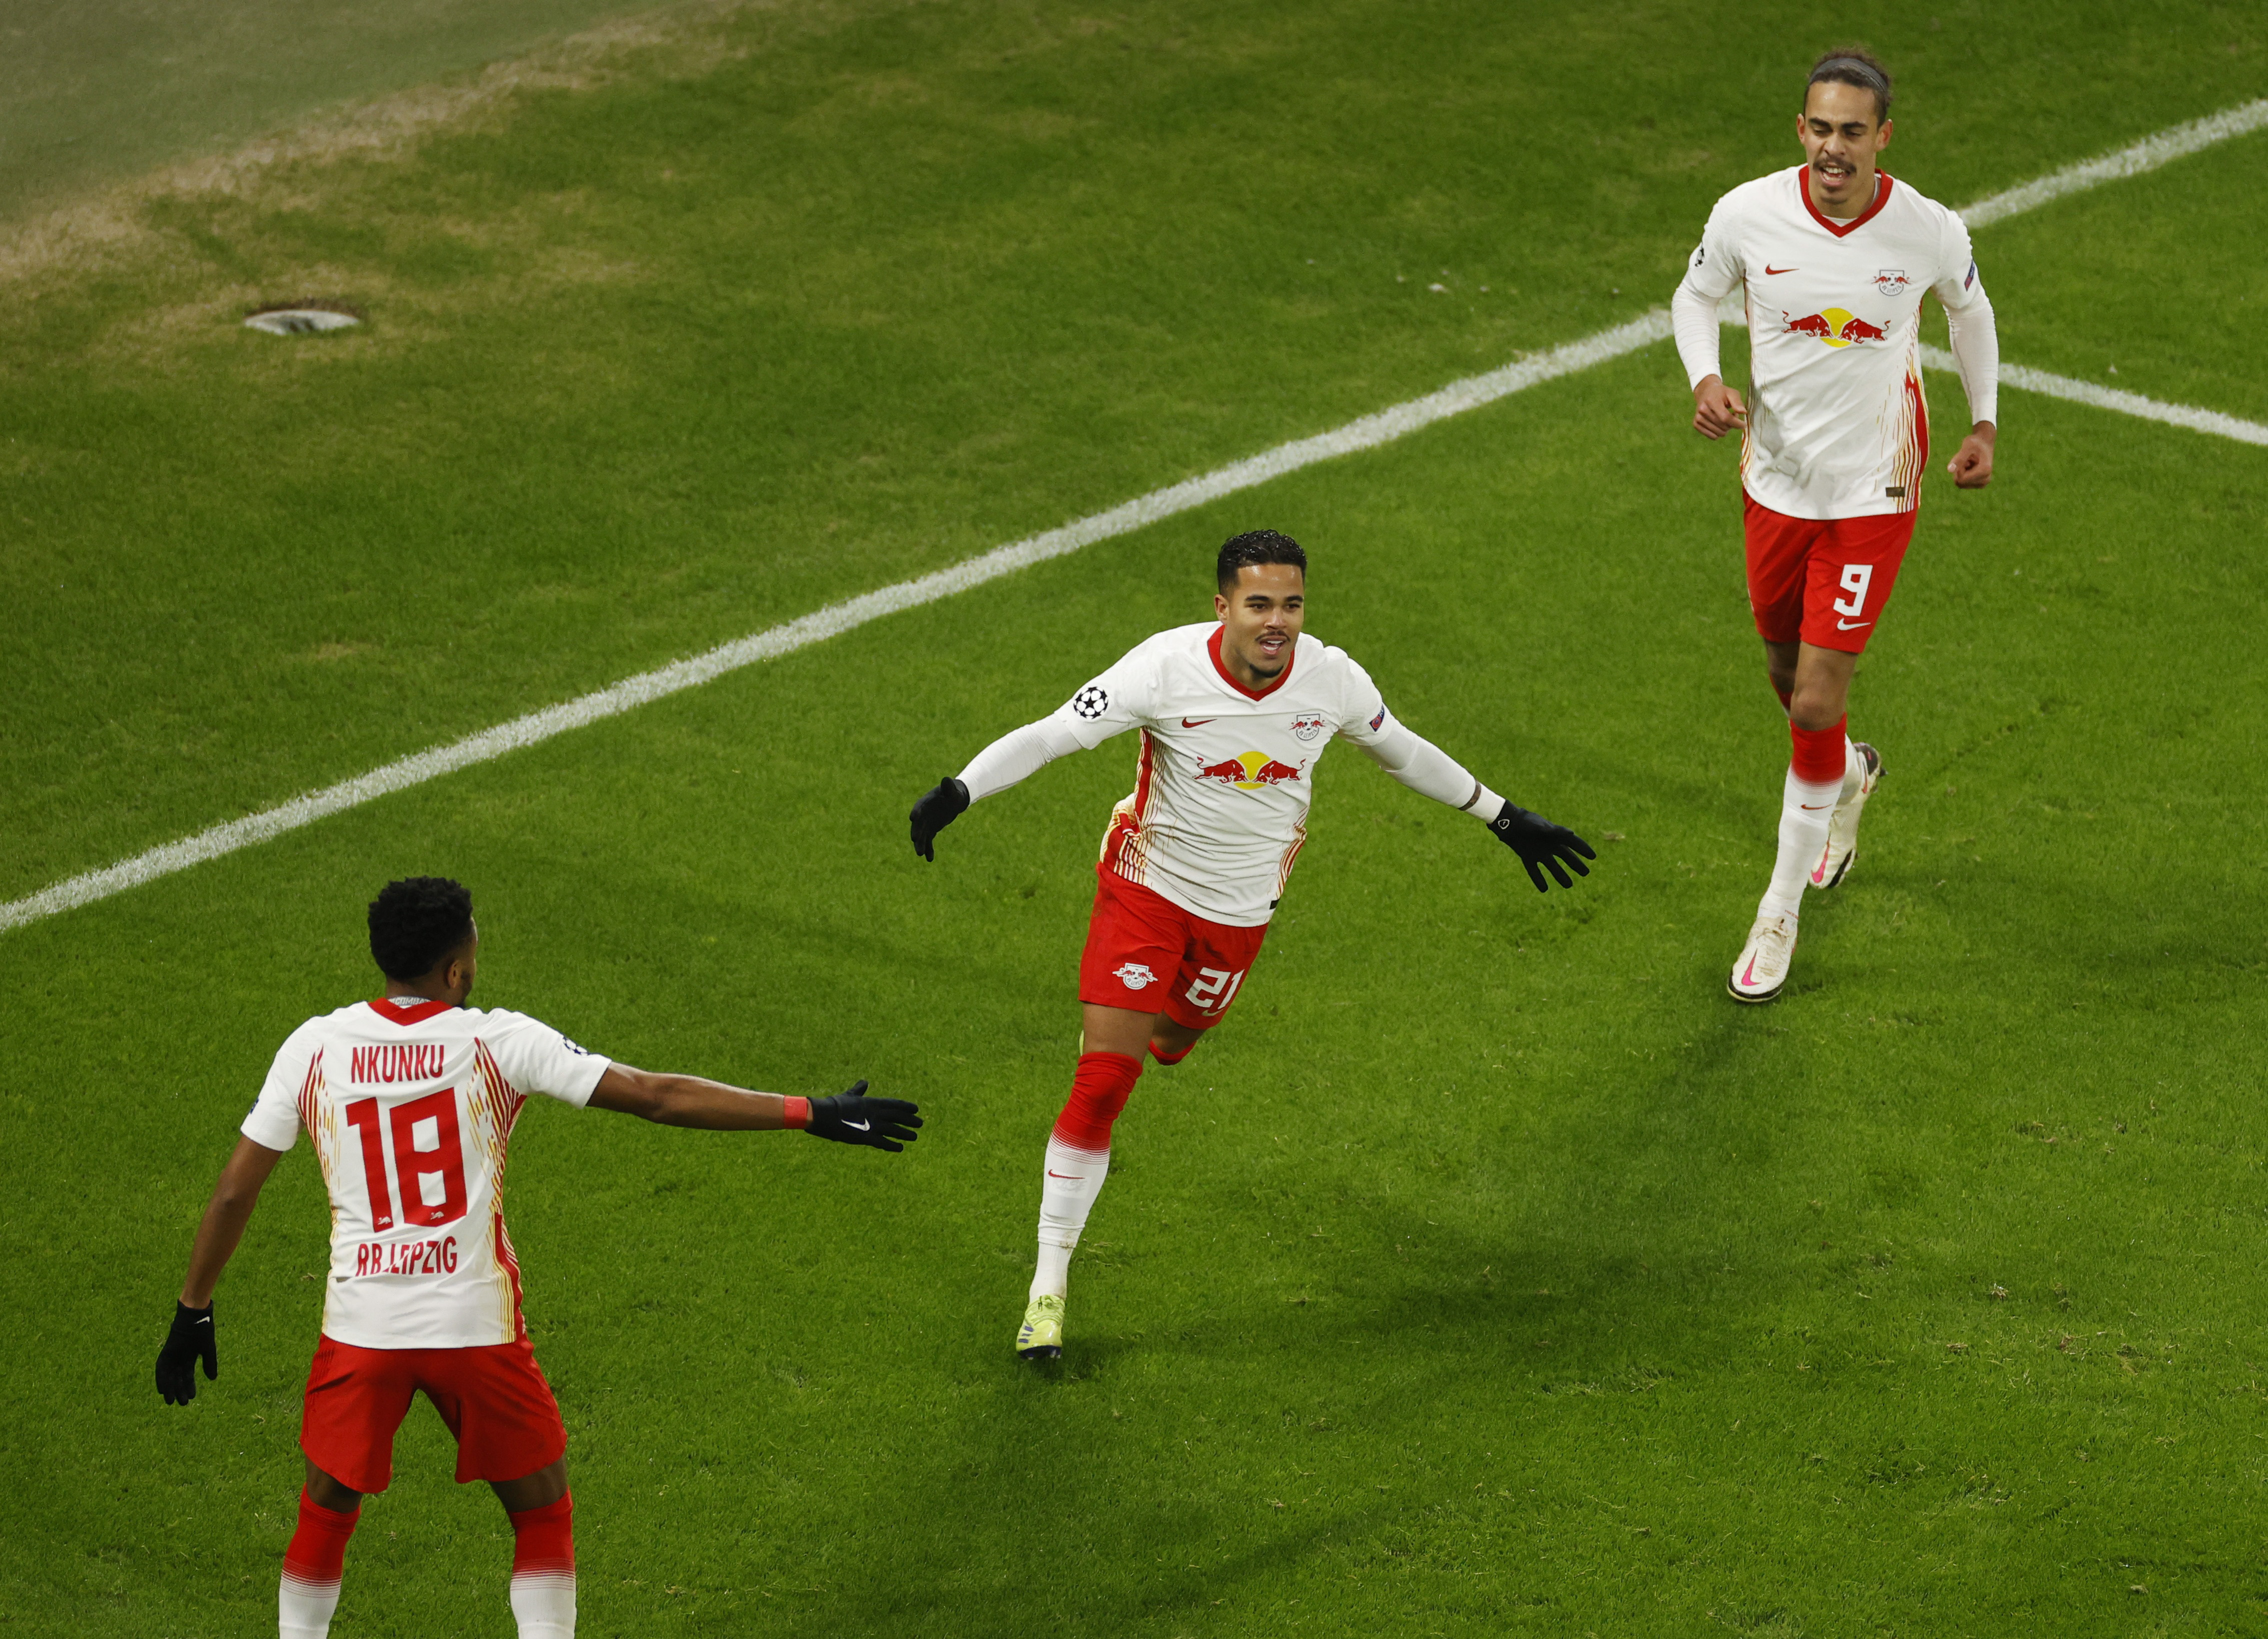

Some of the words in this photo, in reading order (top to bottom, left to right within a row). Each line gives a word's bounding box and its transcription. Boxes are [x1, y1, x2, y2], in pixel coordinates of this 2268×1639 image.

[1833, 564, 1873, 617] 9
[1185, 967, 1245, 1010] 21
[351, 1044, 444, 1084] NKUNKU
[345, 1087, 468, 1233] 18
[355, 1243, 383, 1277] RB
[383, 1236, 458, 1275] LEIPZIG
